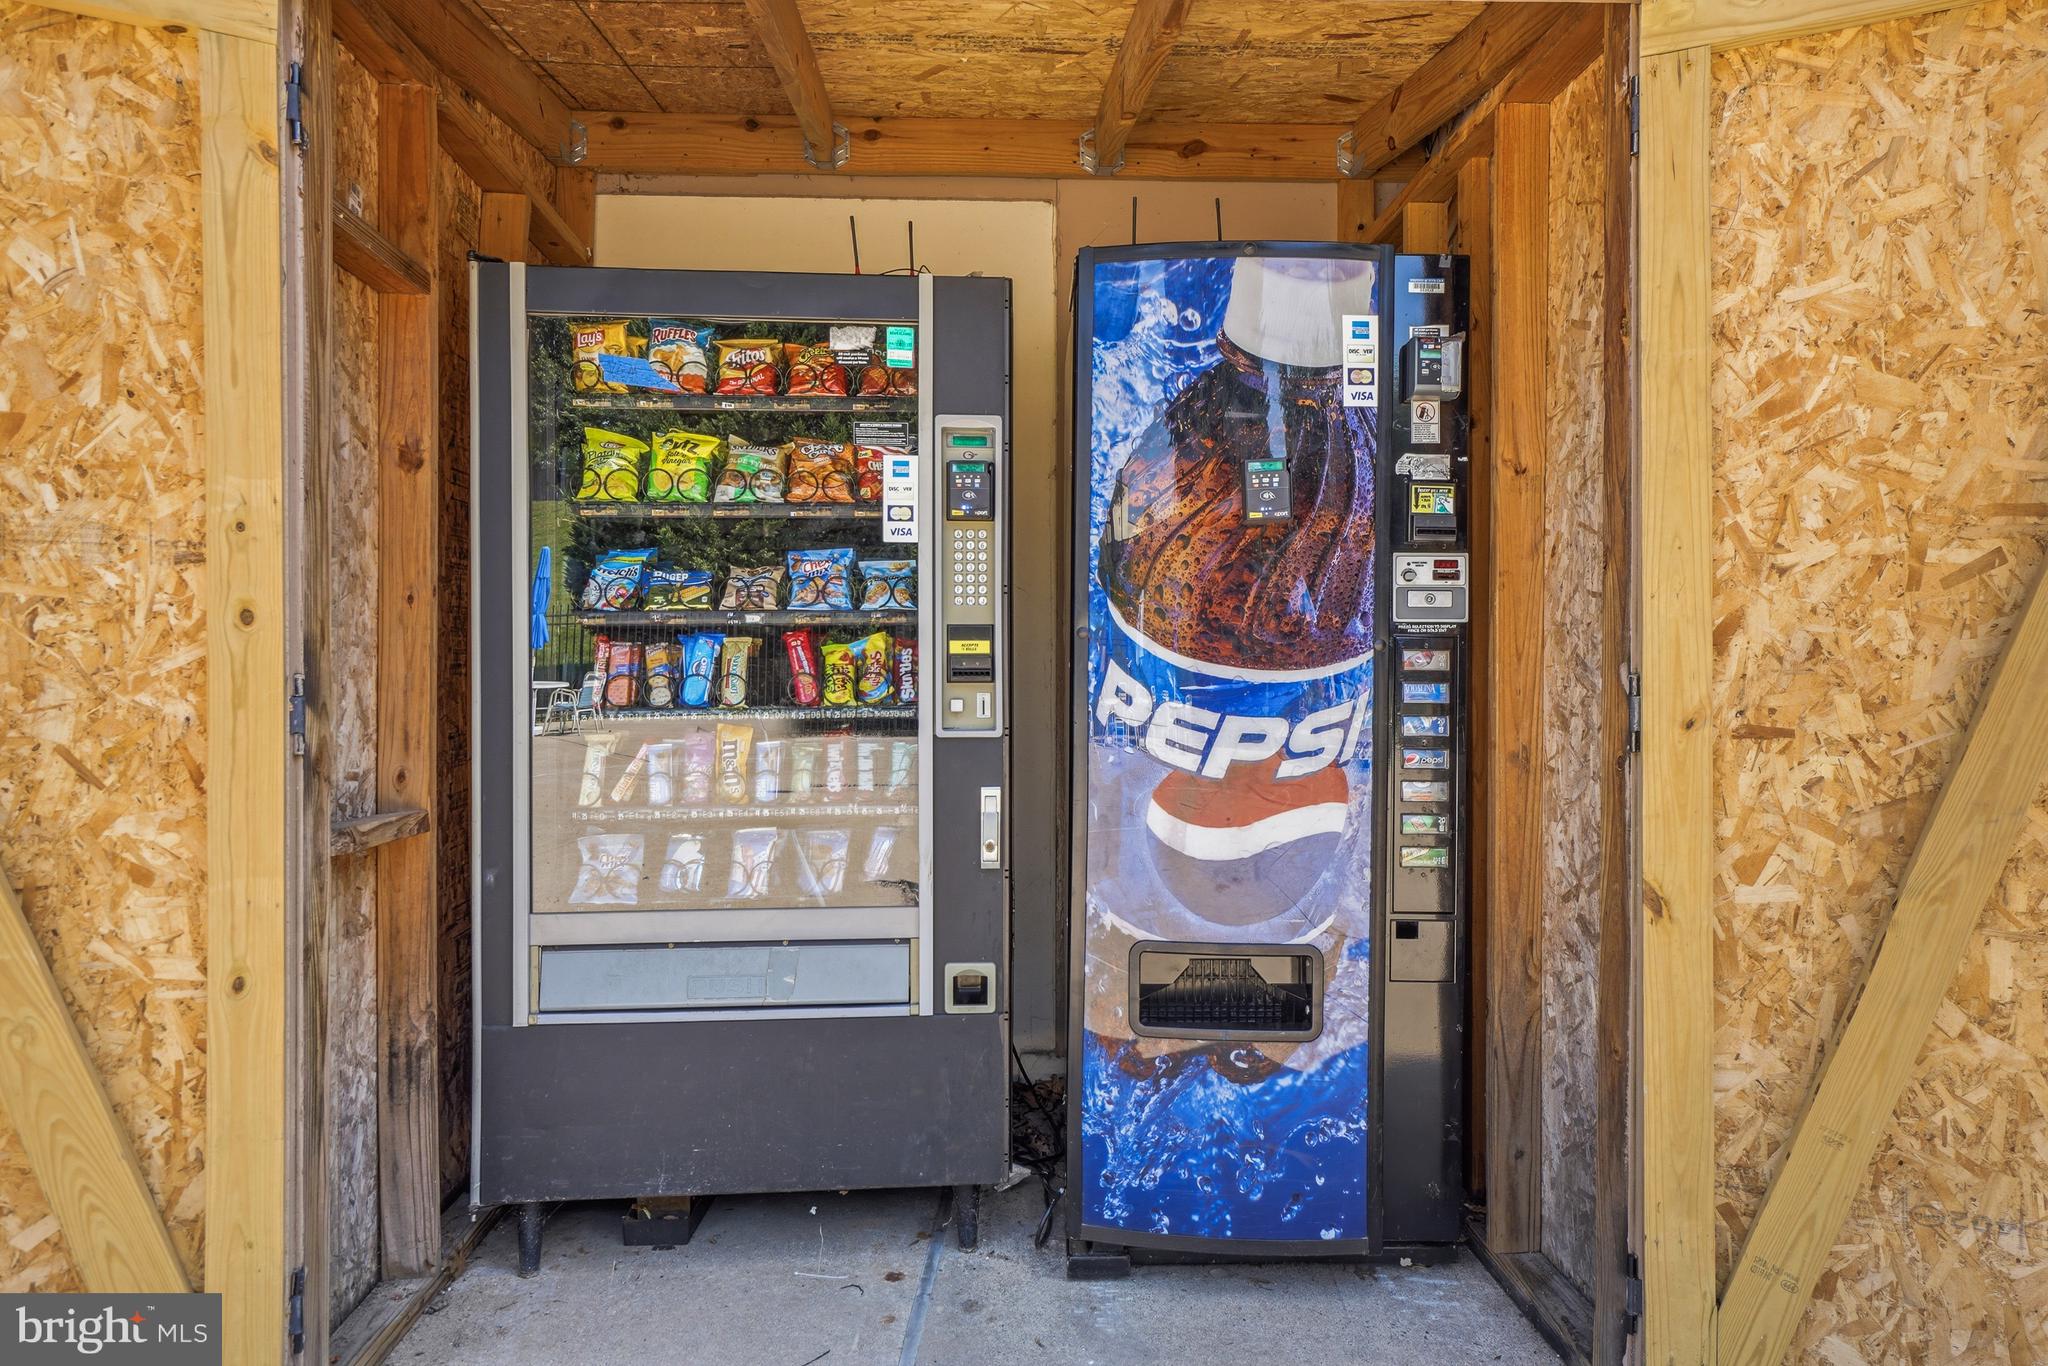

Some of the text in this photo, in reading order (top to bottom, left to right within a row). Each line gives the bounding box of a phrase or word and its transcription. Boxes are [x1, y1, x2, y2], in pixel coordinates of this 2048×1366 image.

[576, 331, 603, 348] Lay's
[652, 327, 697, 344] RUFFLES
[725, 348, 766, 368] Fritos
[1351, 391, 1374, 401] VISA
[890, 527, 913, 537] VISA
[802, 559, 833, 573] Chex
[808, 567, 830, 577] mix
[1095, 659, 1371, 779] PEPSI
